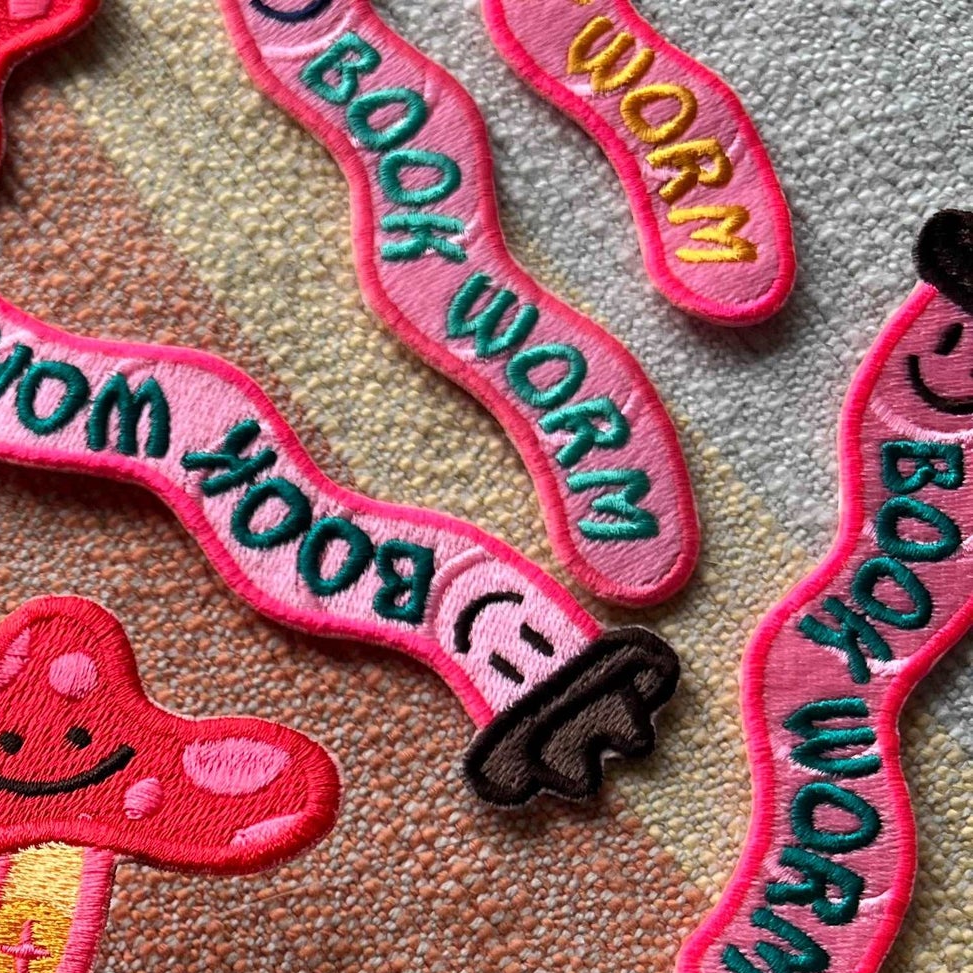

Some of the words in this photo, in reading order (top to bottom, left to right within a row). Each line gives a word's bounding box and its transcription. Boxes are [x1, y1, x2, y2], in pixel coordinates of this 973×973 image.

[568, 15, 759, 263] WORM
[298, 31, 466, 264] BOOK
[446, 272, 660, 541] WORM
[181, 418, 435, 625] BOOK
[798, 439, 963, 684] BOOK
